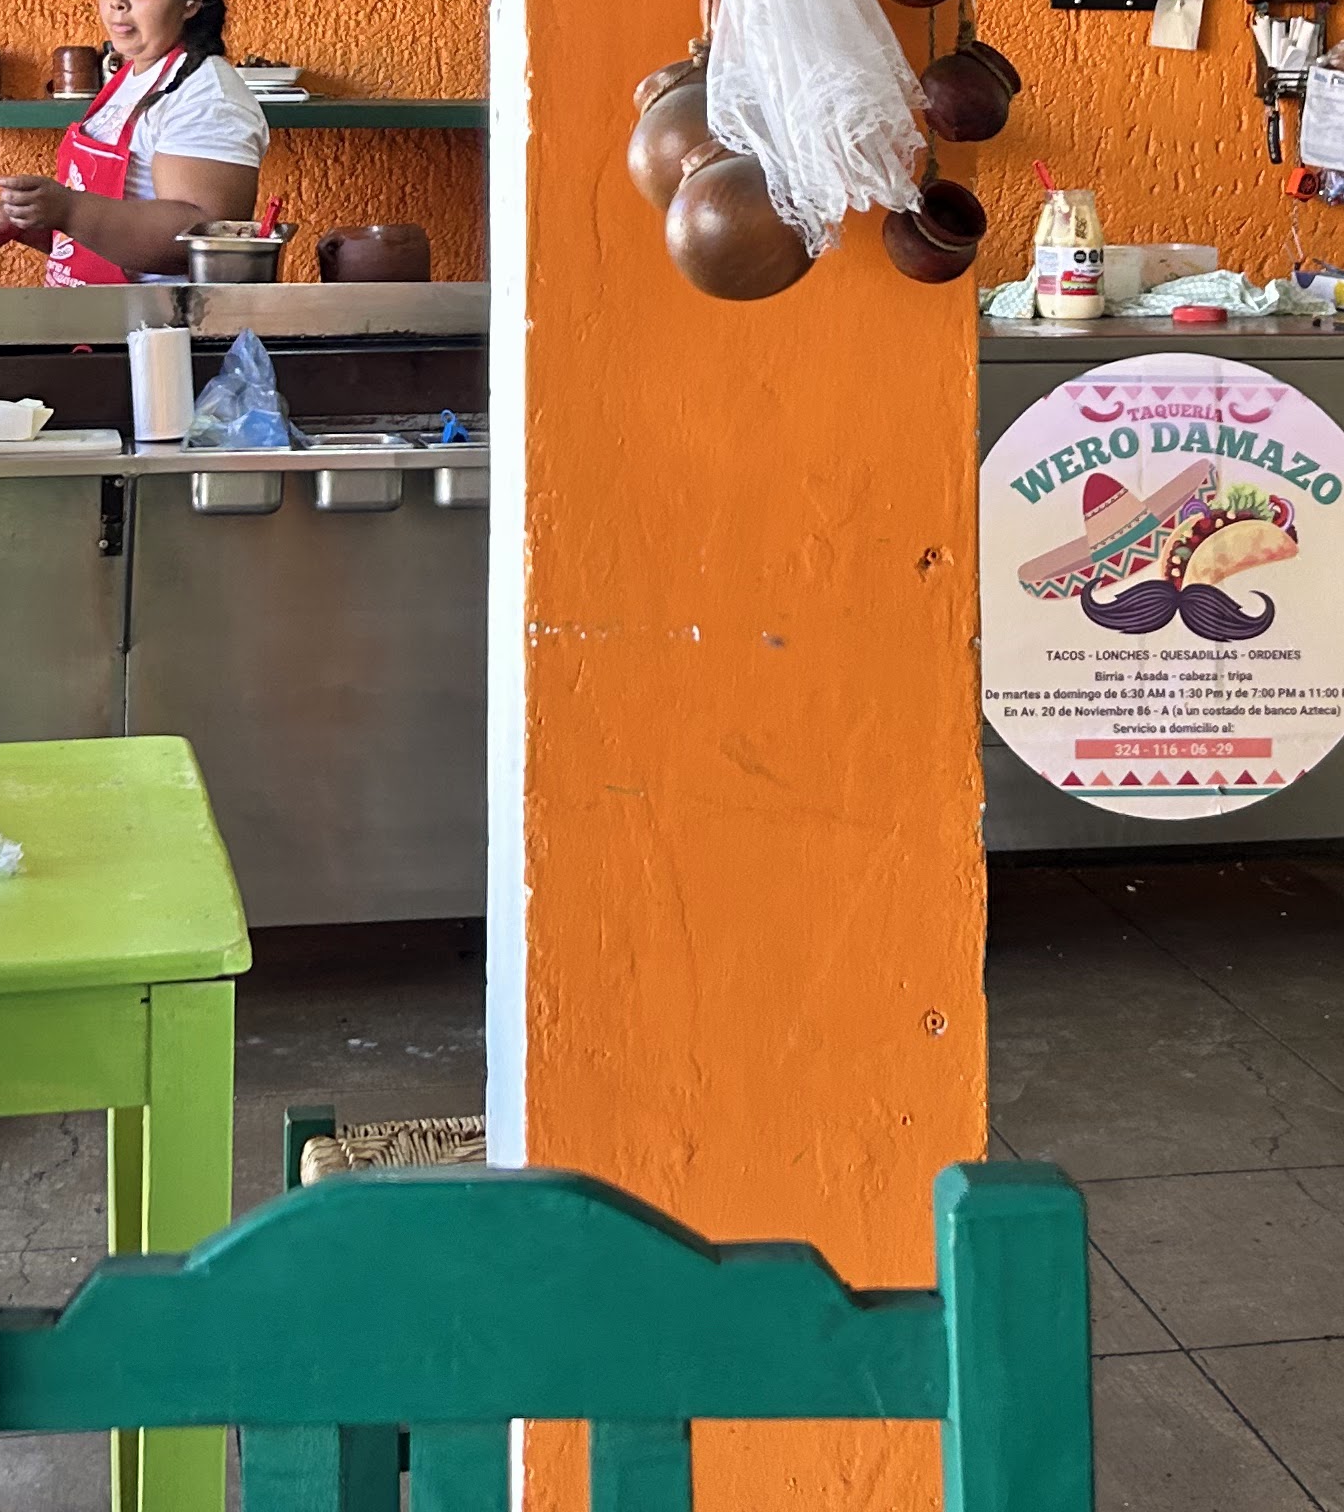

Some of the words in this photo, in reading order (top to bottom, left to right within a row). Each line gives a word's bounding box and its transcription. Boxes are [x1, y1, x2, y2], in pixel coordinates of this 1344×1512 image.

[1126, 402, 1225, 424] TAQUERÍA
[1009, 426, 1142, 506] WERO
[1150, 422, 1344, 506] DAMAZO
[1046, 650, 1086, 661] TACOS
[1095, 649, 1150, 661] LONCHES
[1160, 649, 1238, 661] QUESADILLAS
[1248, 649, 1302, 661] ORDENES
[1094, 671, 1125, 682] Birria
[1134, 670, 1169, 682] Asada
[1179, 670, 1218, 682] cabeza
[1228, 671, 1253, 683] tripa
[985, 689, 1000, 700] De
[1002, 689, 1041, 700] martes
[1043, 691, 1051, 700] a
[1053, 689, 1102, 702] domingo
[1104, 688, 1118, 699] de
[1147, 688, 1166, 699] AM
[1168, 690, 1176, 699] a
[1225, 690, 1232, 701] y
[1235, 688, 1249, 699] de
[1251, 688, 1275, 699] 7:00
[1278, 688, 1297, 699] PM
[1298, 690, 1306, 699] a
[1309, 687, 1339, 698] 11:00
[1004, 706, 1018, 717] En
[1041, 706, 1056, 717] 20
[1058, 706, 1072, 717] de
[1074, 705, 1134, 717] Noviembre
[1161, 705, 1170, 716] A
[1172, 705, 1183, 718] (a
[1186, 706, 1200, 716] un
[1203, 705, 1246, 716] costado
[1248, 705, 1262, 716] de
[1264, 705, 1298, 716] banco
[1299, 705, 1341, 717] Azteca)
[1112, 723, 1157, 734] Servicio
[1159, 725, 1166, 734] a
[1169, 723, 1219, 734] domicilio
[1221, 723, 1235, 734] al:
[1114, 743, 1140, 756] 324
[1153, 743, 1178, 755] 116
[1190, 742, 1207, 755] 06
